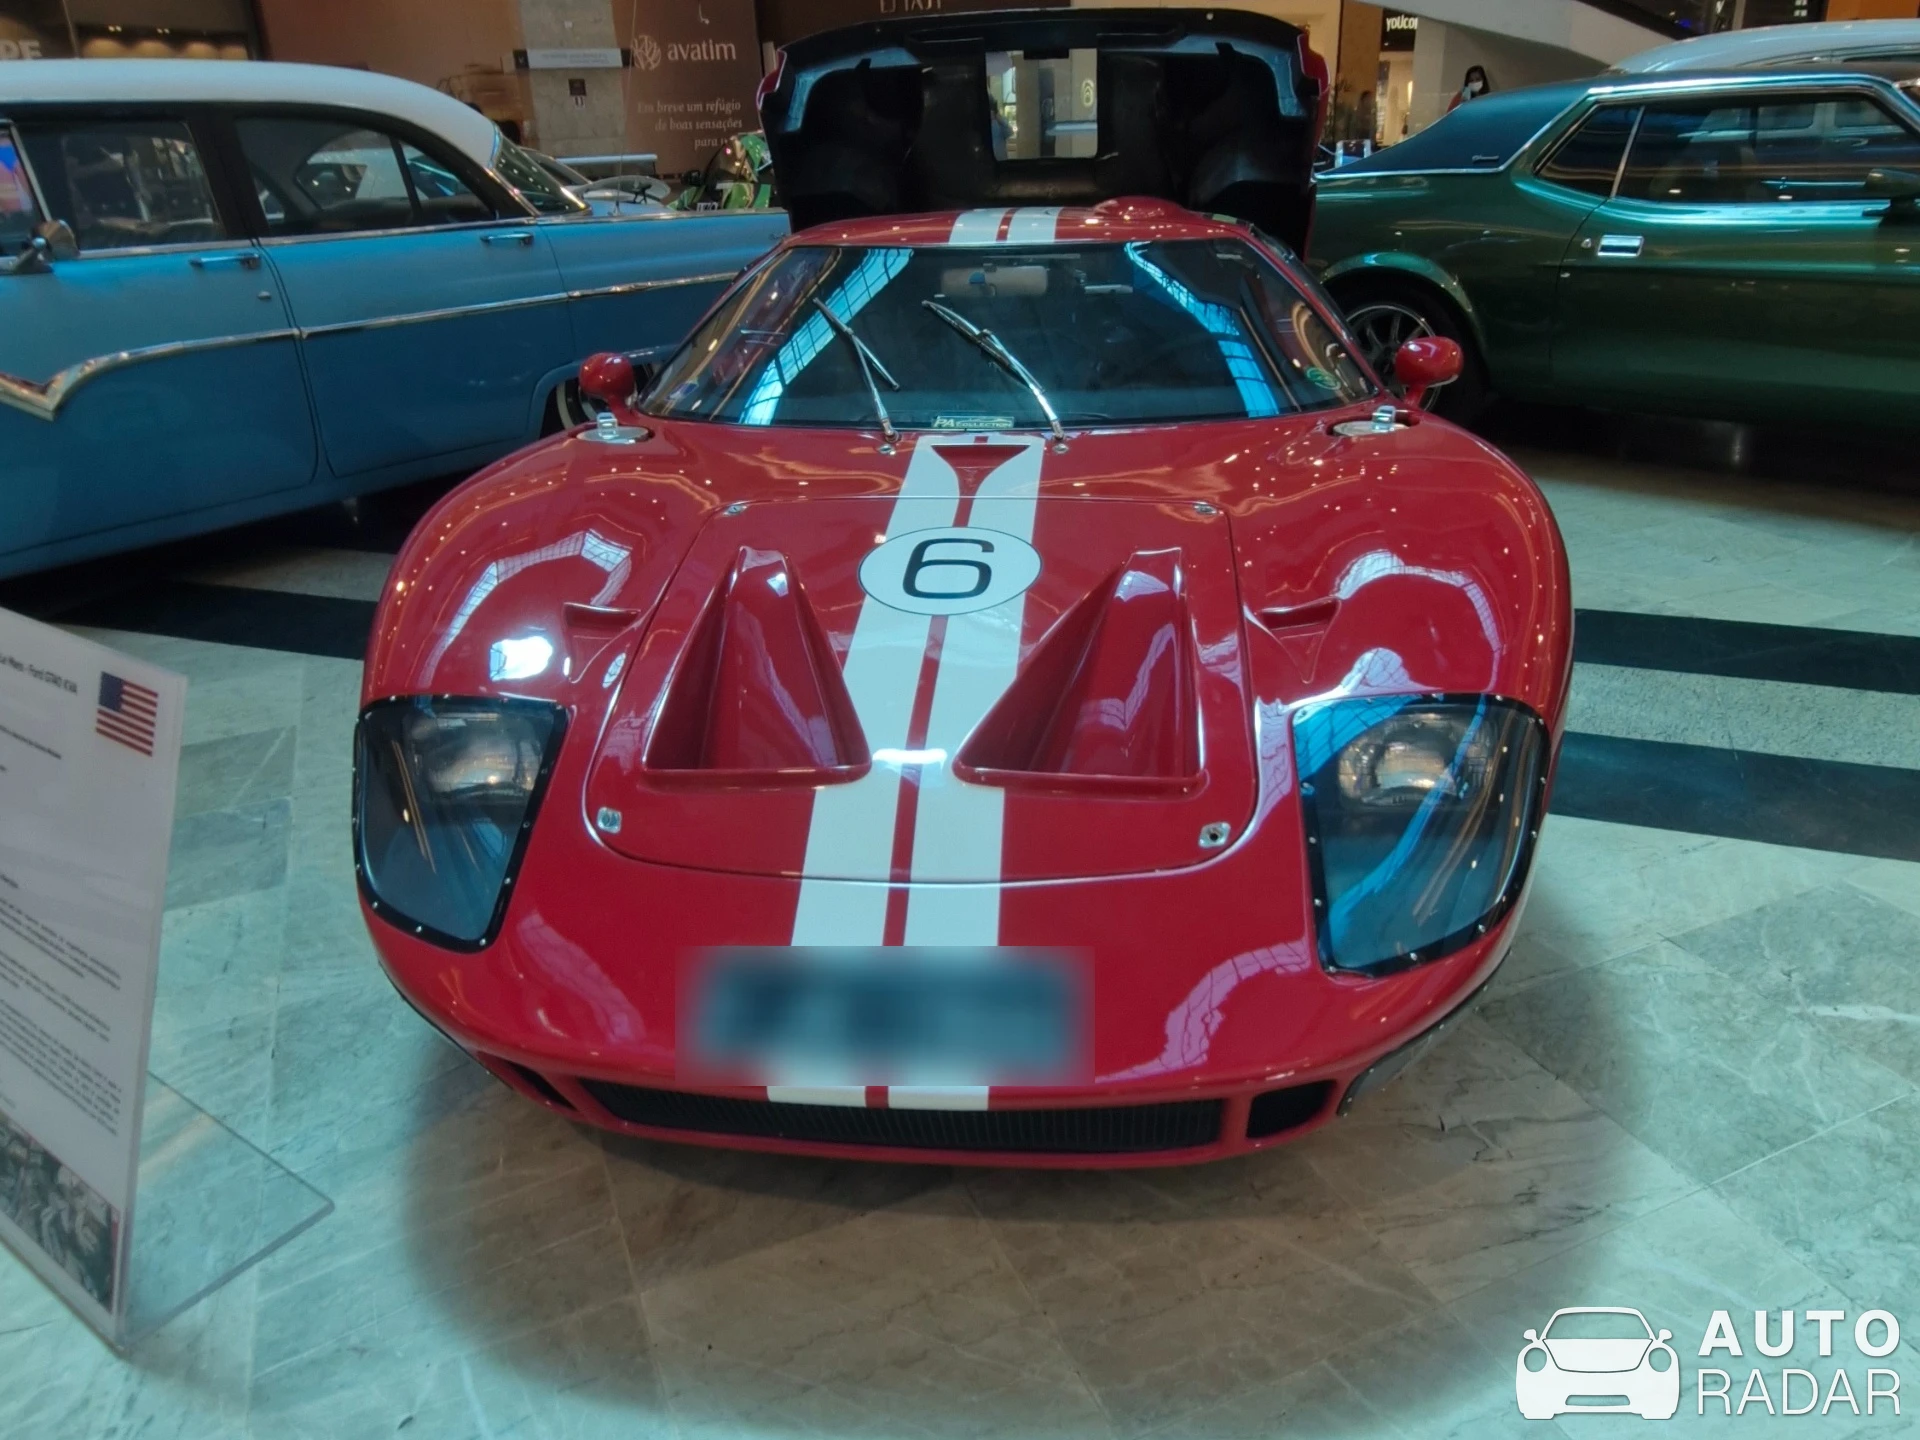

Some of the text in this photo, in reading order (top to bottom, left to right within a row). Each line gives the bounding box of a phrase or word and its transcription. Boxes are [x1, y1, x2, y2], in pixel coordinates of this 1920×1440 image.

[667, 39, 737, 61] avatim
[657, 101, 684, 112] breve
[687, 102, 703, 112] um
[706, 98, 741, 114] refúgio
[655, 117, 742, 131] de boas sensações
[695, 138, 718, 150] para
[933, 418, 1012, 428] PA COLLECTION
[902, 538, 995, 599] 6
